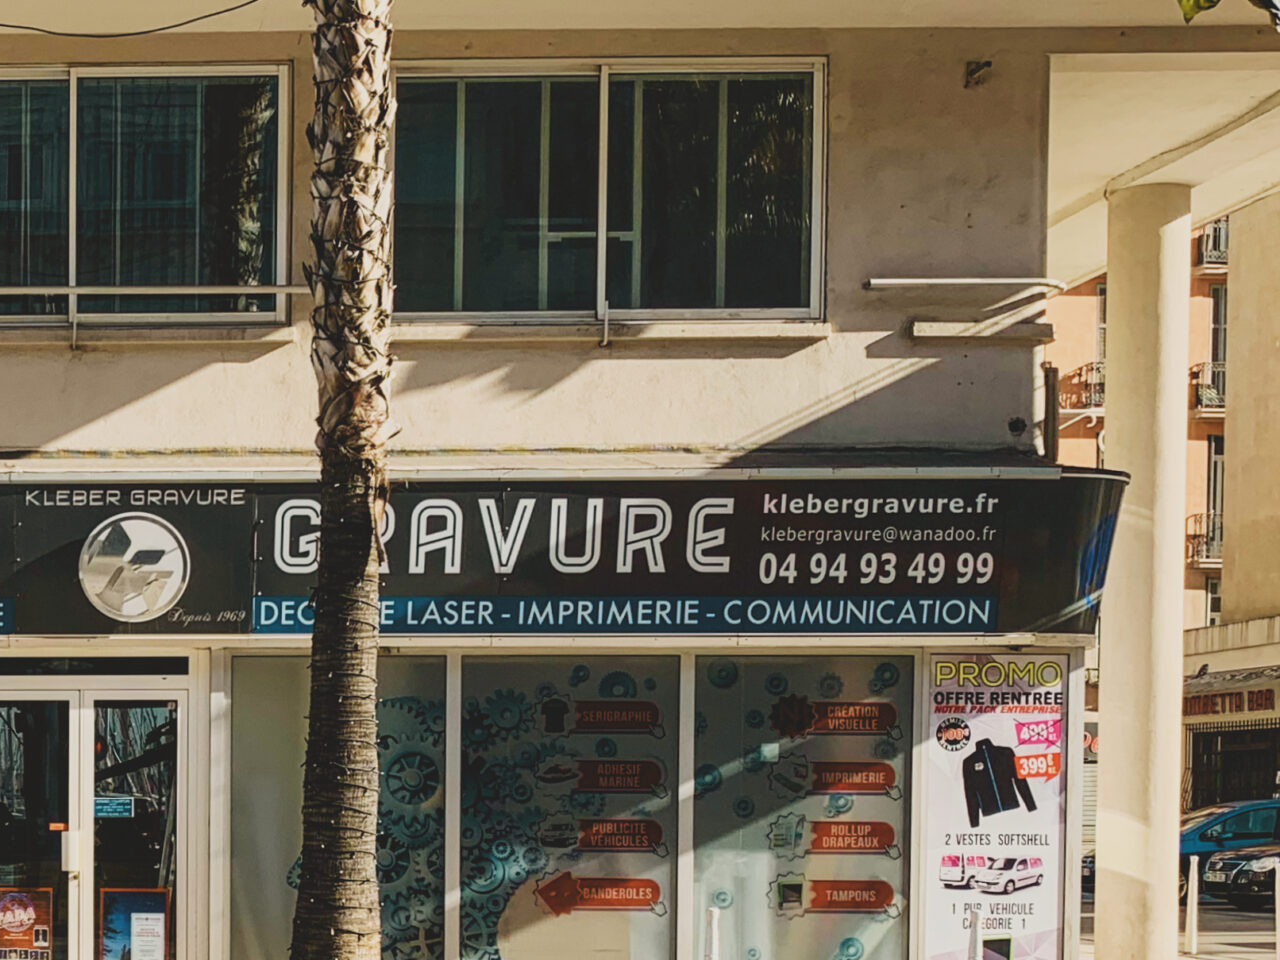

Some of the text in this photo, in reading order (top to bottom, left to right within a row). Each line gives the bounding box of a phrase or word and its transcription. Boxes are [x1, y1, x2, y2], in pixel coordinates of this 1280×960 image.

[25, 489, 246, 506] KLEBER GRAVURE
[763, 493, 999, 518] klebergravure.fr
[274, 497, 735, 575] GAVURE
[761, 526, 997, 544] klebergravure@wanadoo.fr
[759, 552, 994, 585] 04 94 93 49 99
[167, 607, 246, 628] Depuis 1969
[260, 600, 395, 626] DECE
[406, 600, 493, 626] LASER
[519, 599, 700, 626] IMPRIMERIE
[723, 599, 991, 626] COMMUNICATION
[934, 661, 1063, 687] PROMO
[933, 690, 1064, 705] OFFRE RENTRÉE
[934, 705, 1063, 714] NOTRE PACK ENTREPRISE
[583, 711, 652, 722] SERIGRAPHIE
[827, 718, 879, 730] VISUELLE
[599, 776, 640, 787] MARINE
[822, 772, 887, 784] IMPRIMERIE
[592, 822, 647, 834] PUBLICITE
[830, 824, 872, 835] ROLLUP
[822, 837, 879, 848] DRAPEAUX
[945, 834, 1050, 846] 2 VESTES SOFTSHELL
[583, 887, 653, 899] BANDEROLES
[825, 890, 877, 902] TAMPONS
[952, 903, 956, 915] 1
[989, 902, 1035, 915] VEHICULE
[963, 917, 1026, 930] CEGORIE 1
